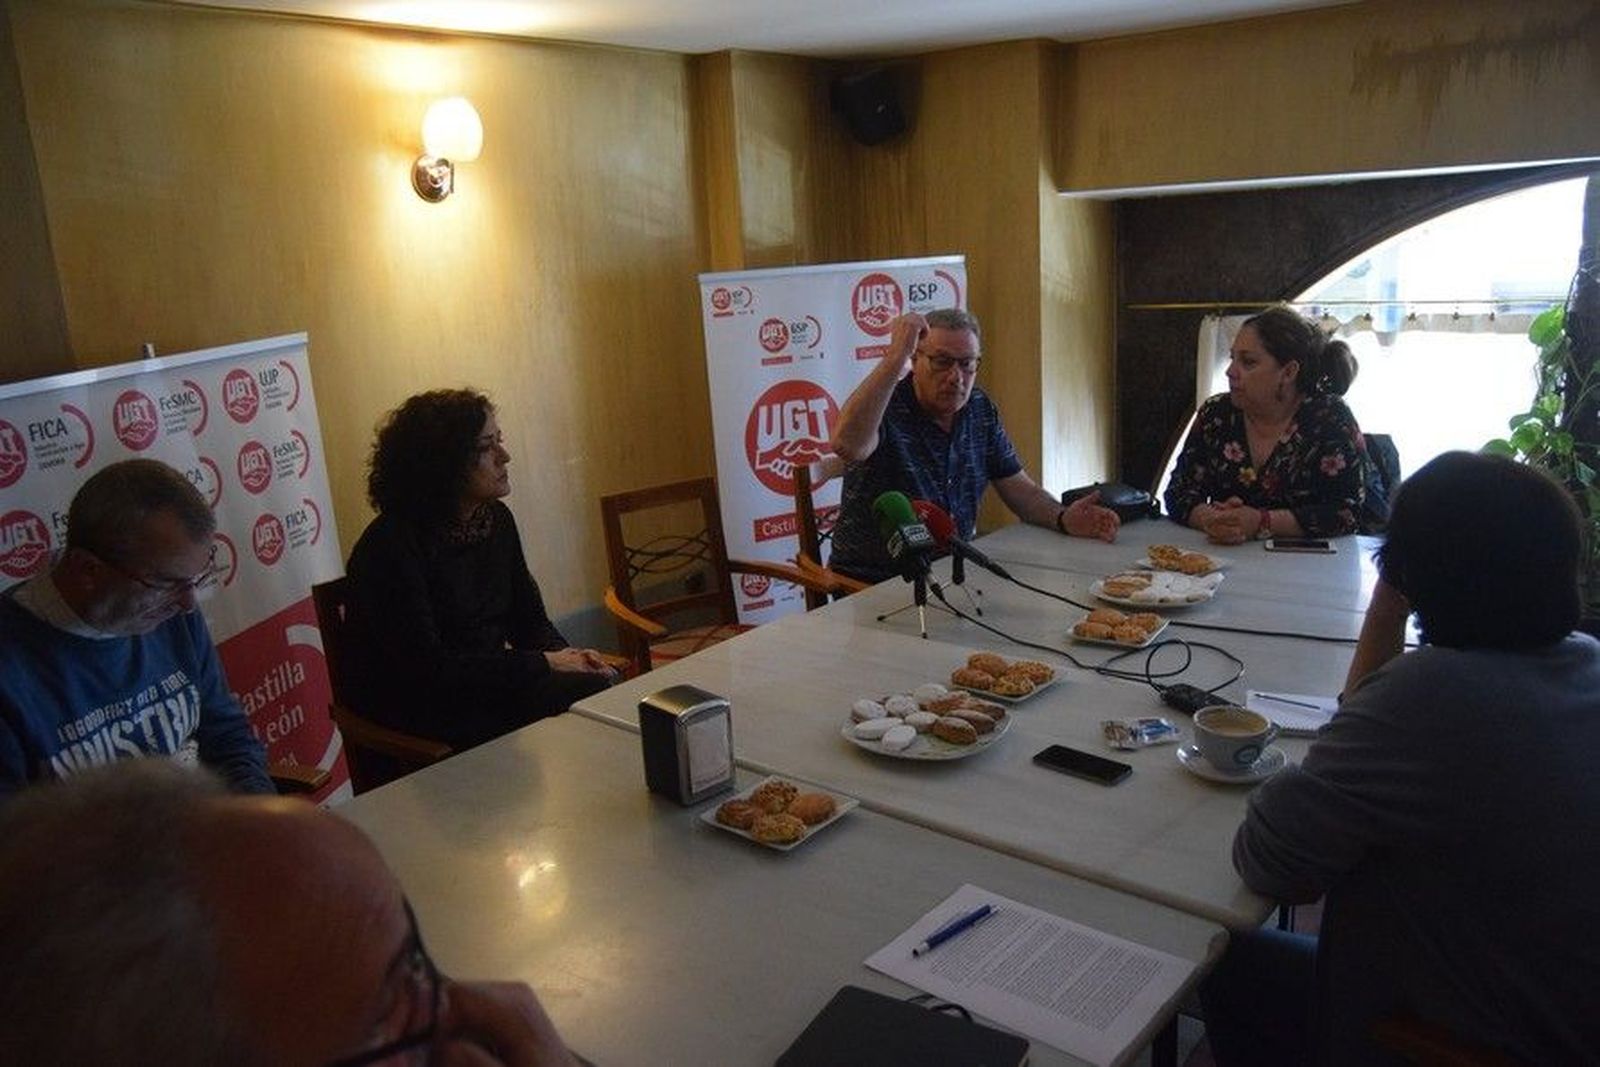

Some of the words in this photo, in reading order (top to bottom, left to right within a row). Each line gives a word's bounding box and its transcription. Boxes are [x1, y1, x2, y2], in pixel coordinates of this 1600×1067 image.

[859, 284, 896, 308] UGT
[117, 400, 152, 428] UGT
[757, 398, 832, 451] UGT
[28, 417, 68, 442] FICA
